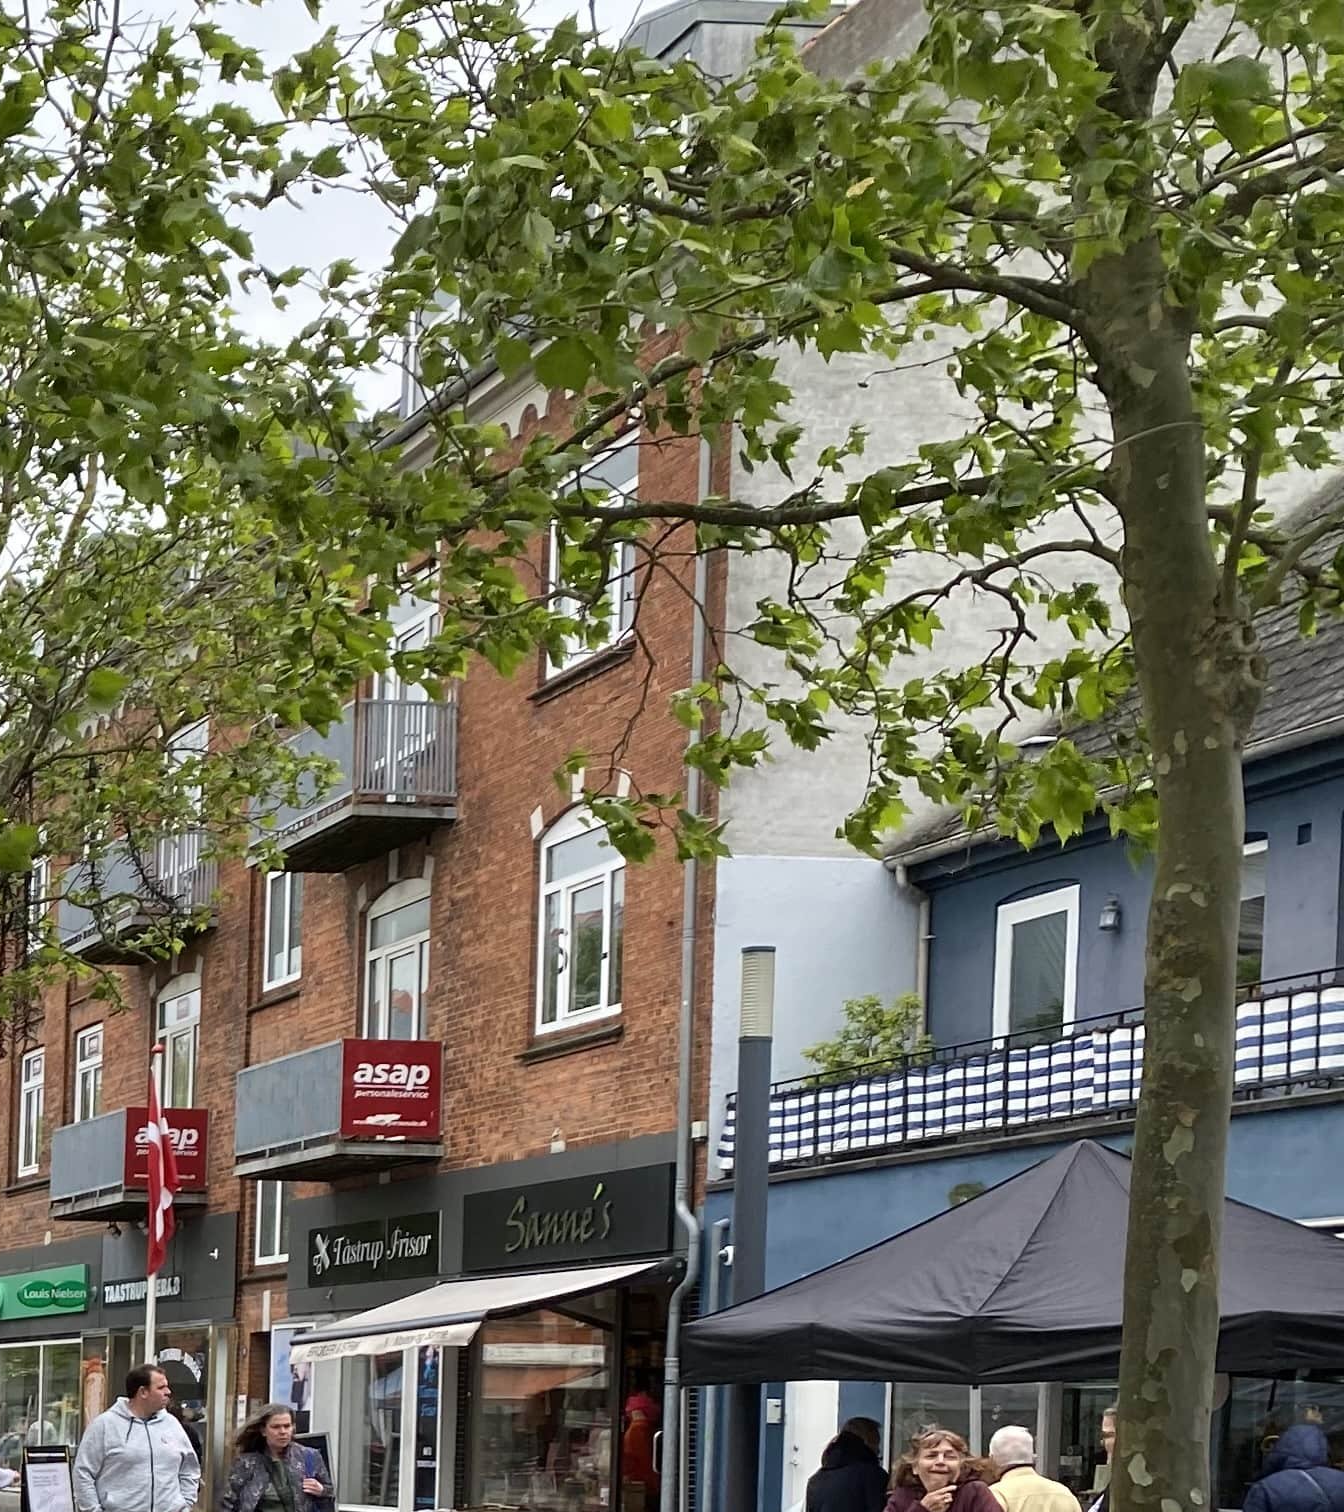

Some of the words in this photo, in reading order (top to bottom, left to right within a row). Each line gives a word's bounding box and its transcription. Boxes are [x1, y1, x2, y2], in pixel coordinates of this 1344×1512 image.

[353, 1061, 431, 1091] asap
[353, 1088, 430, 1100] personaleservice
[134, 1126, 199, 1150] aap
[333, 1236, 384, 1270] Tåstrup
[23, 1287, 50, 1299] Louis
[50, 1287, 87, 1299] Nielsen
[154, 1276, 181, 1298] EBAB
